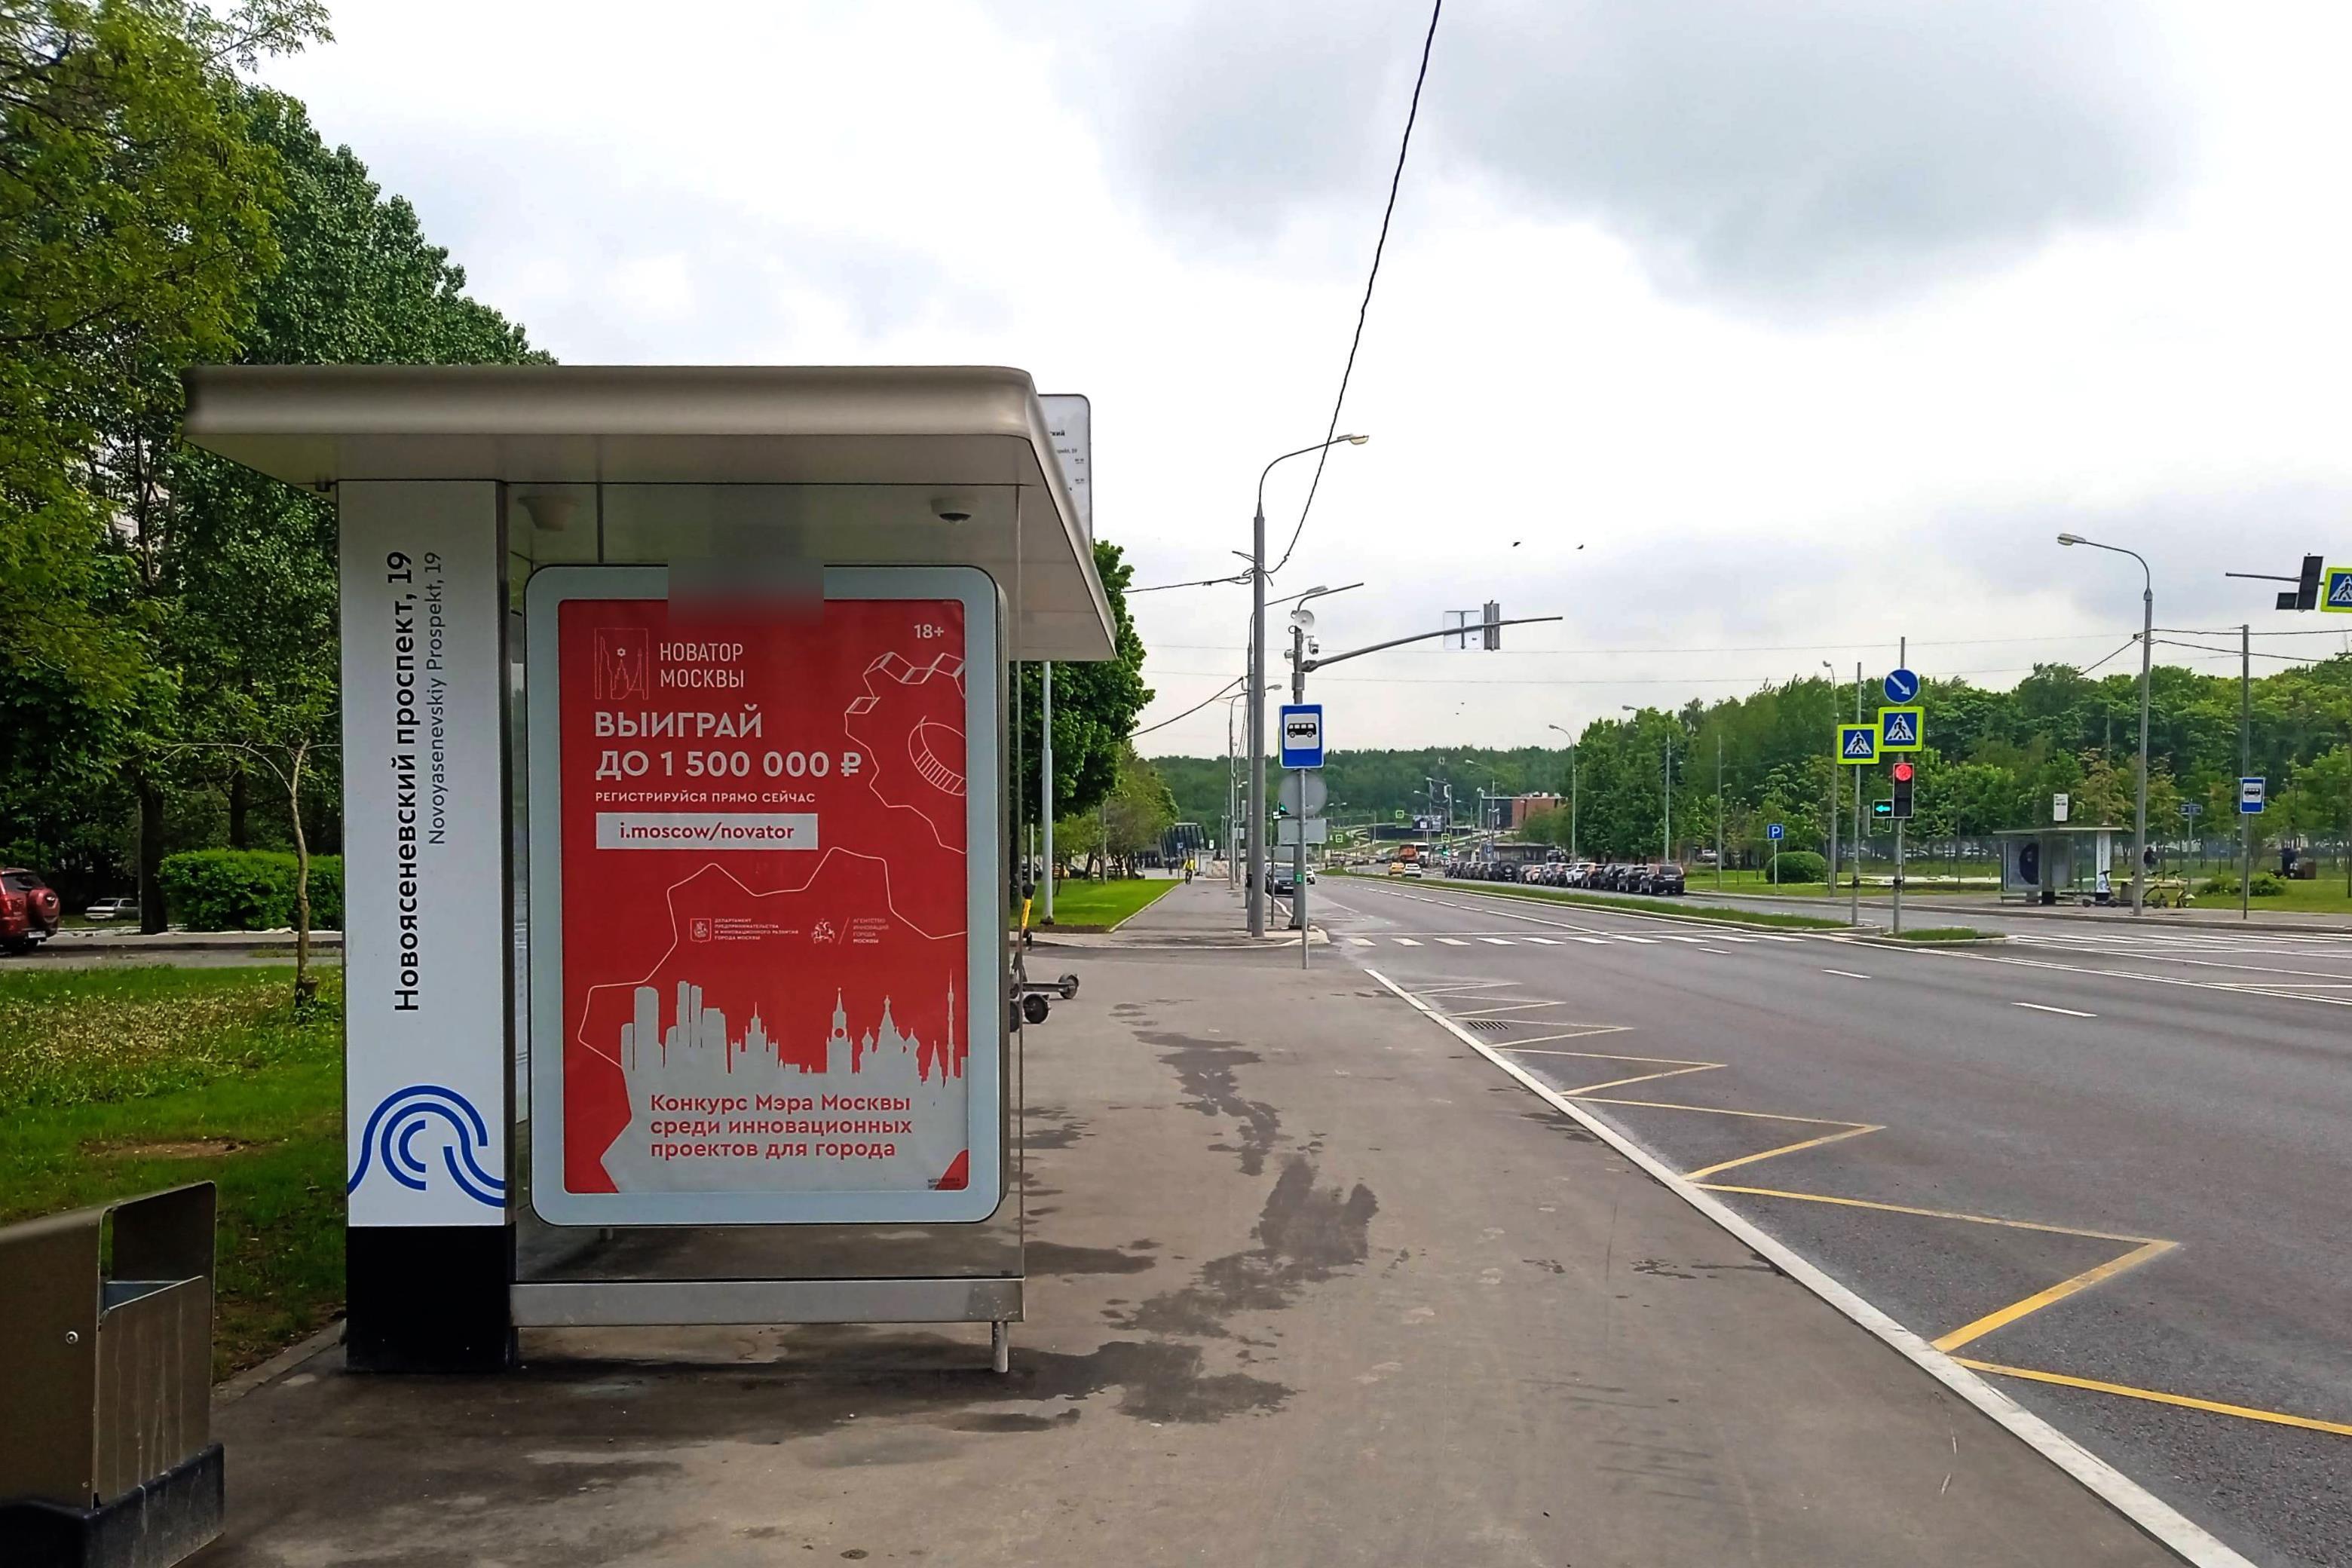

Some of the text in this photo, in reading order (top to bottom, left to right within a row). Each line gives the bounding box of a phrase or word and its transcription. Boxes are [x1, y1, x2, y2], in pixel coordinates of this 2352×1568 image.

[914, 623, 945, 639] 18+
[660, 642, 743, 662] НОВАТОР
[660, 669, 745, 688] МОСКВЫ
[424, 551, 448, 844] Novoyasenevskiy Prospekt, 19
[595, 703, 762, 738] ВЫИГРАЙ
[596, 750, 649, 781] ДО
[660, 752, 672, 776] 1
[685, 751, 750, 777] 500
[763, 751, 829, 777] 000
[386, 551, 420, 1011] Новоясеневский проспект, 19
[596, 789, 815, 803] РЕГИСТРИРУЙСЯ ПРЯМО СЕЙЧАС
[620, 822, 795, 841] i.moscow/novator
[651, 1093, 910, 1116] Конкурс Мэра Москвы
[650, 1119, 912, 1139] среди инновационных
[651, 1142, 896, 1162] проектов для города
